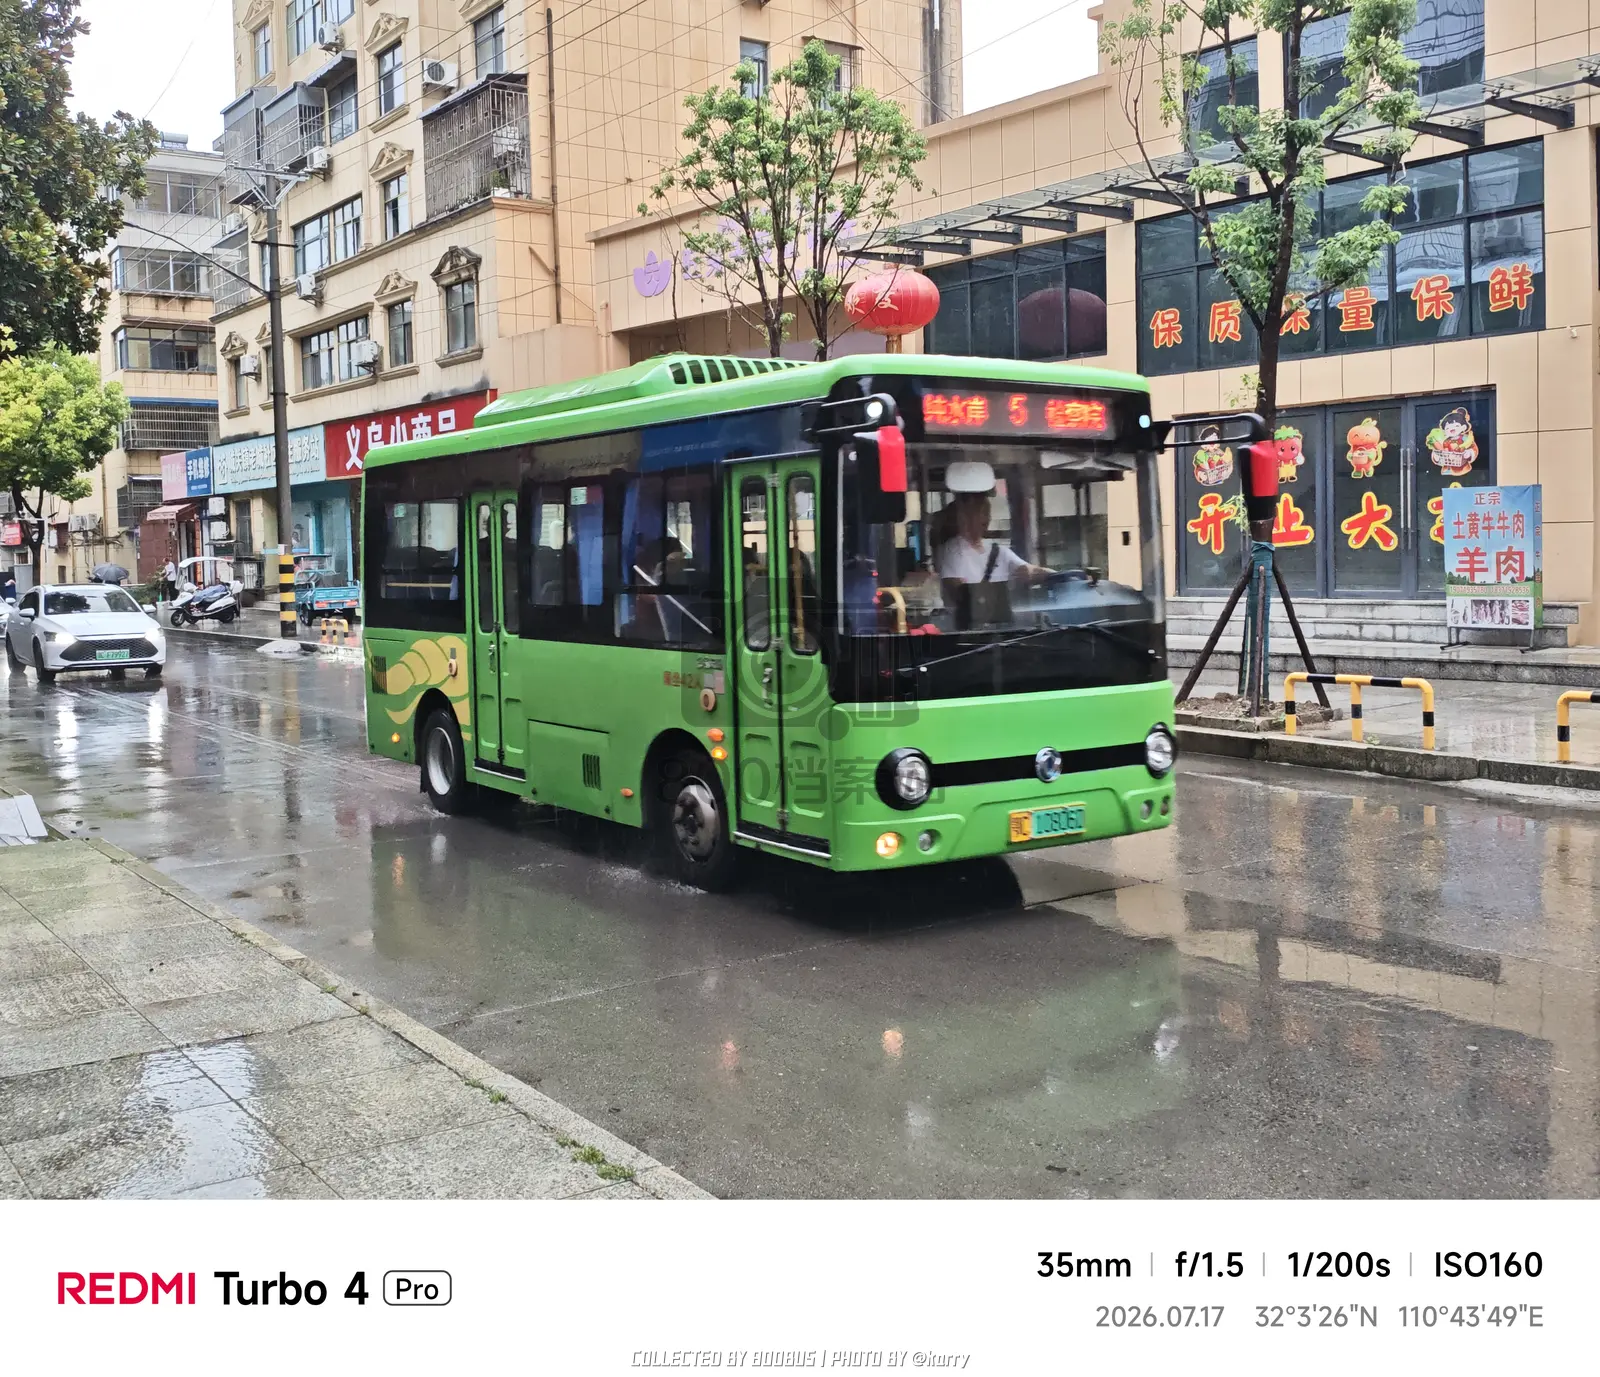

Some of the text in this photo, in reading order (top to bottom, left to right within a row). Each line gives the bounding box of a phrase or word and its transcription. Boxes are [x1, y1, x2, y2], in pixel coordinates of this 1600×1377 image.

[1149, 262, 1535, 349] 保质保量保鲜
[1009, 393, 1028, 426] 5
[1474, 491, 1501, 505] 正宗
[1187, 484, 1446, 554] 开业大
[1452, 509, 1525, 540] 土黄牛牛肉
[1455, 545, 1526, 583] 羊肉
